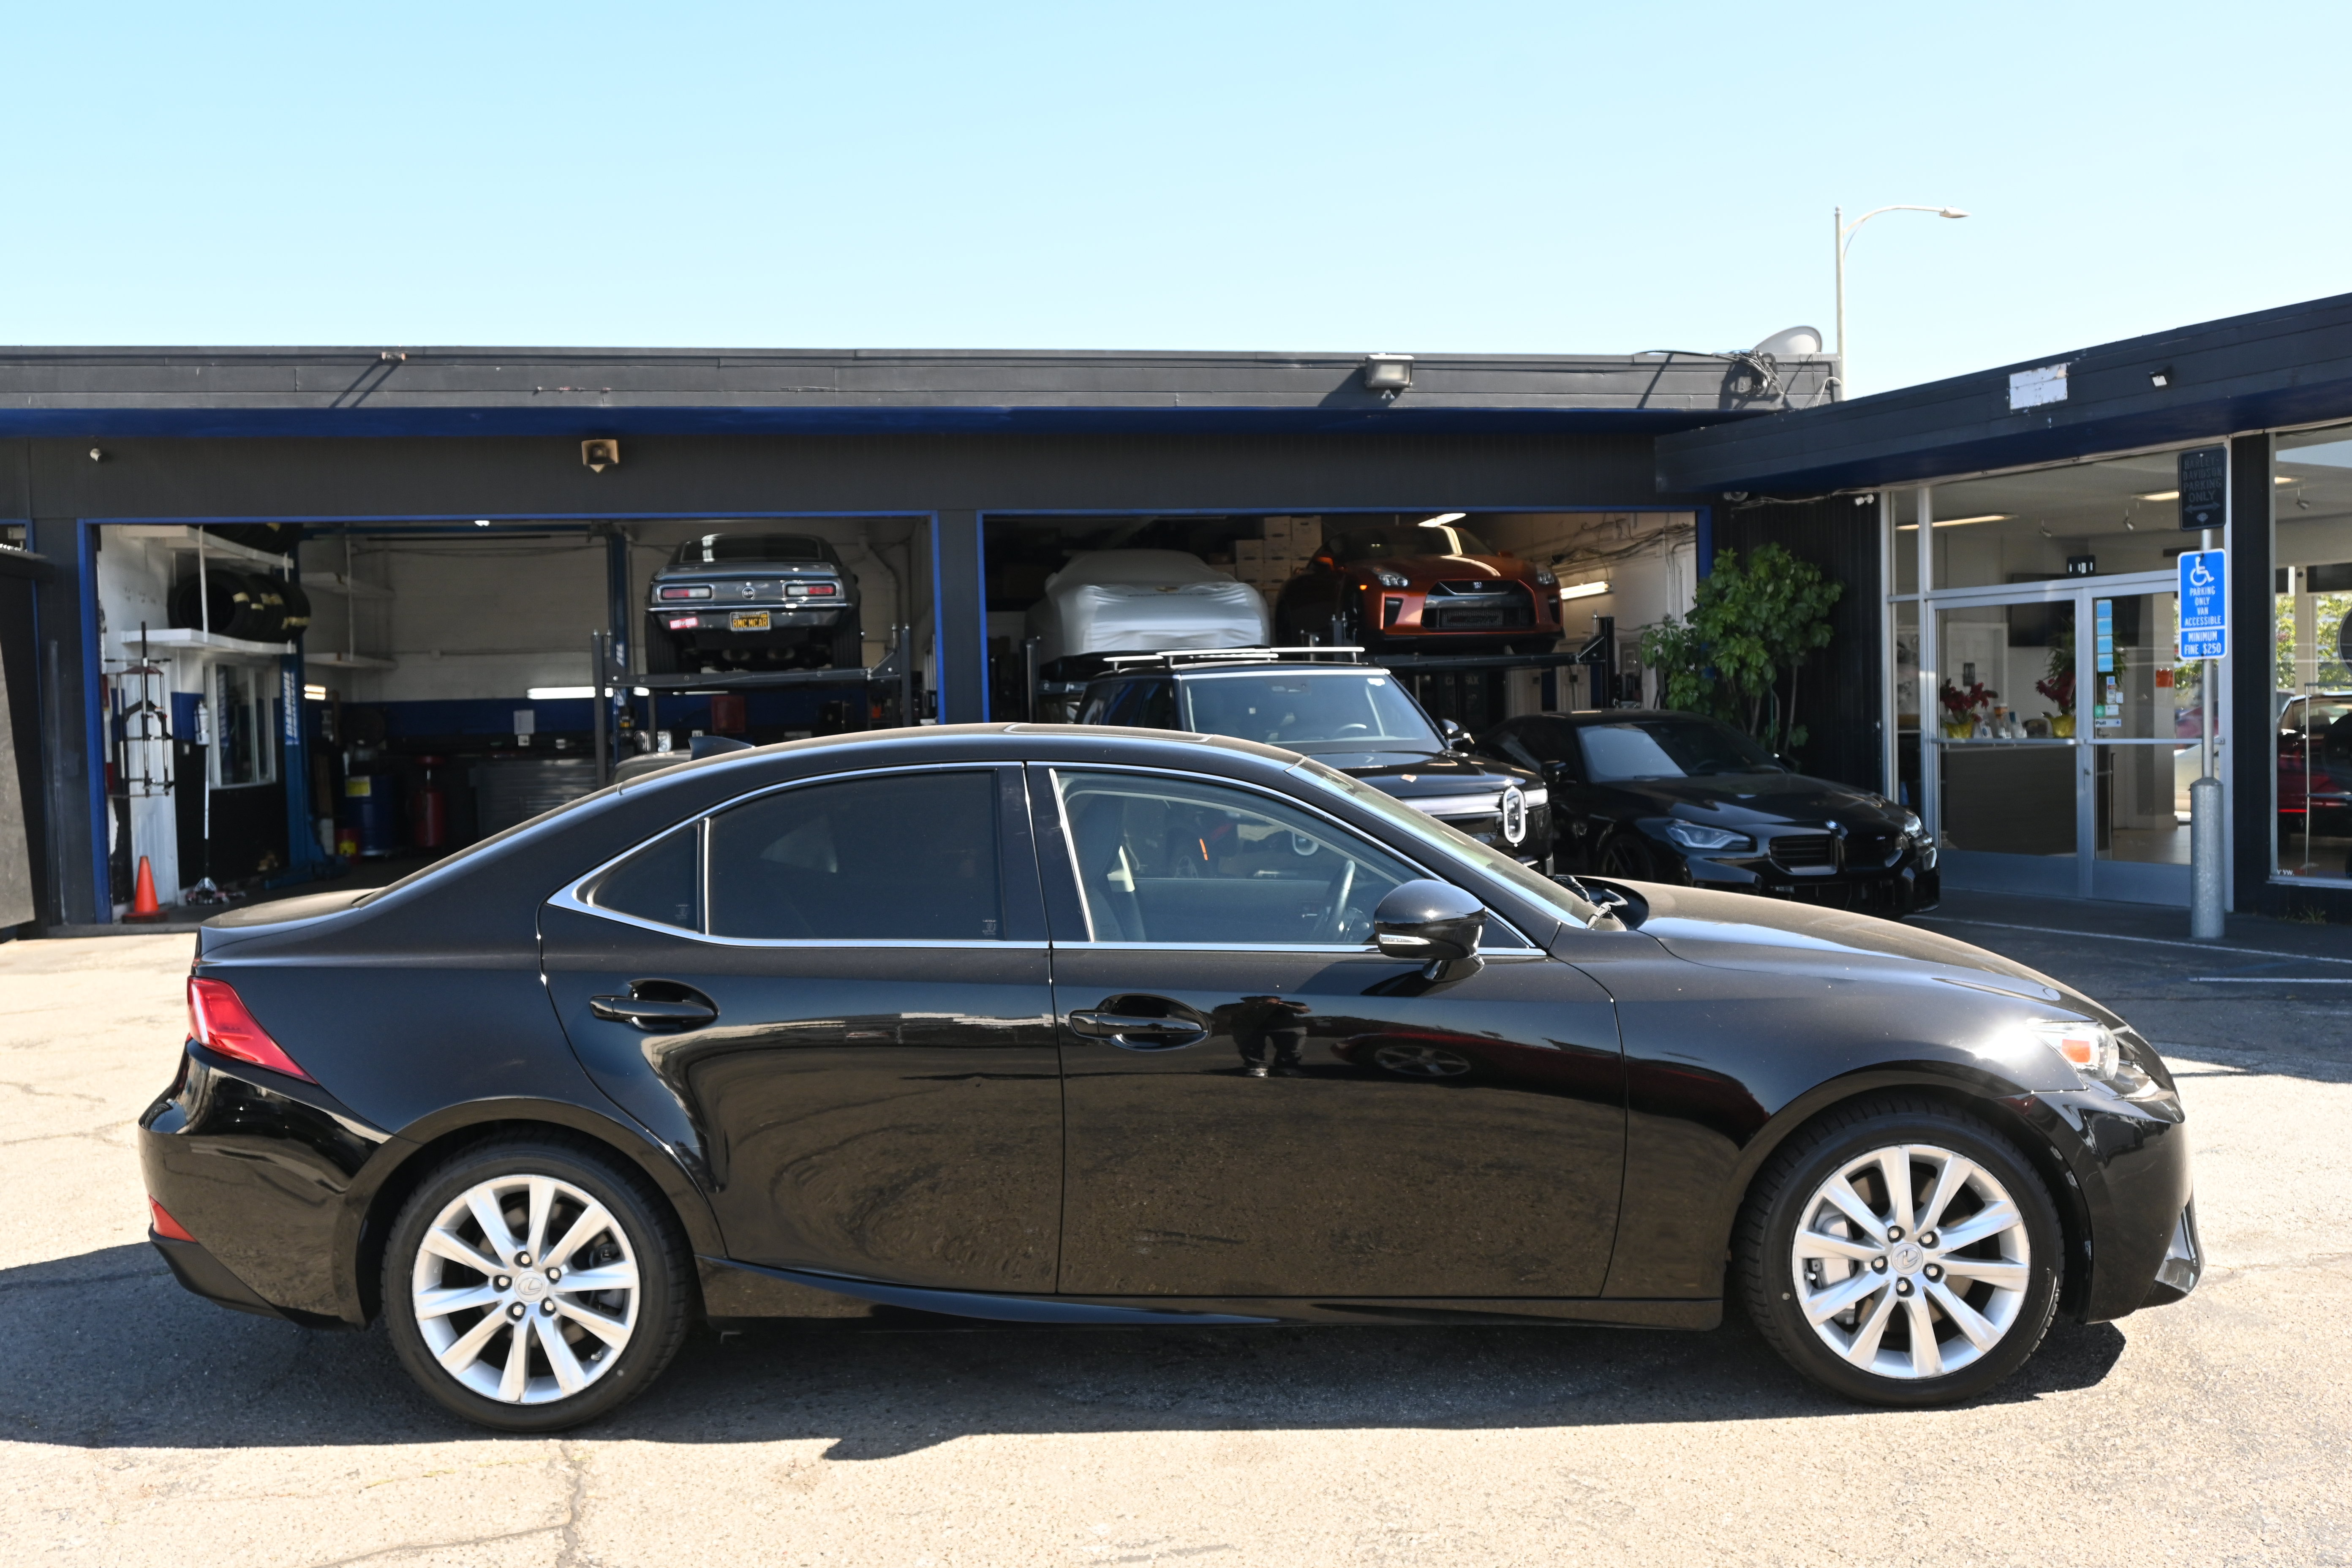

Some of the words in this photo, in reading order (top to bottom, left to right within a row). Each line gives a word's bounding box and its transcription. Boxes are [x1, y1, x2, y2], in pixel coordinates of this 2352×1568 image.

[2183, 478, 2221, 492] PARKING
[2189, 491, 2215, 502] ONLY
[2190, 586, 2216, 596] PARKING
[2195, 597, 2210, 606] ONLY
[2197, 607, 2209, 615] VAN
[733, 619, 747, 628] RMC
[749, 618, 767, 627] MCAR
[2185, 615, 2221, 626] ACCESSIBLE
[2188, 631, 2217, 642] MINIMUM
[2184, 644, 2199, 655] FINE
[2202, 642, 2221, 655] $250
